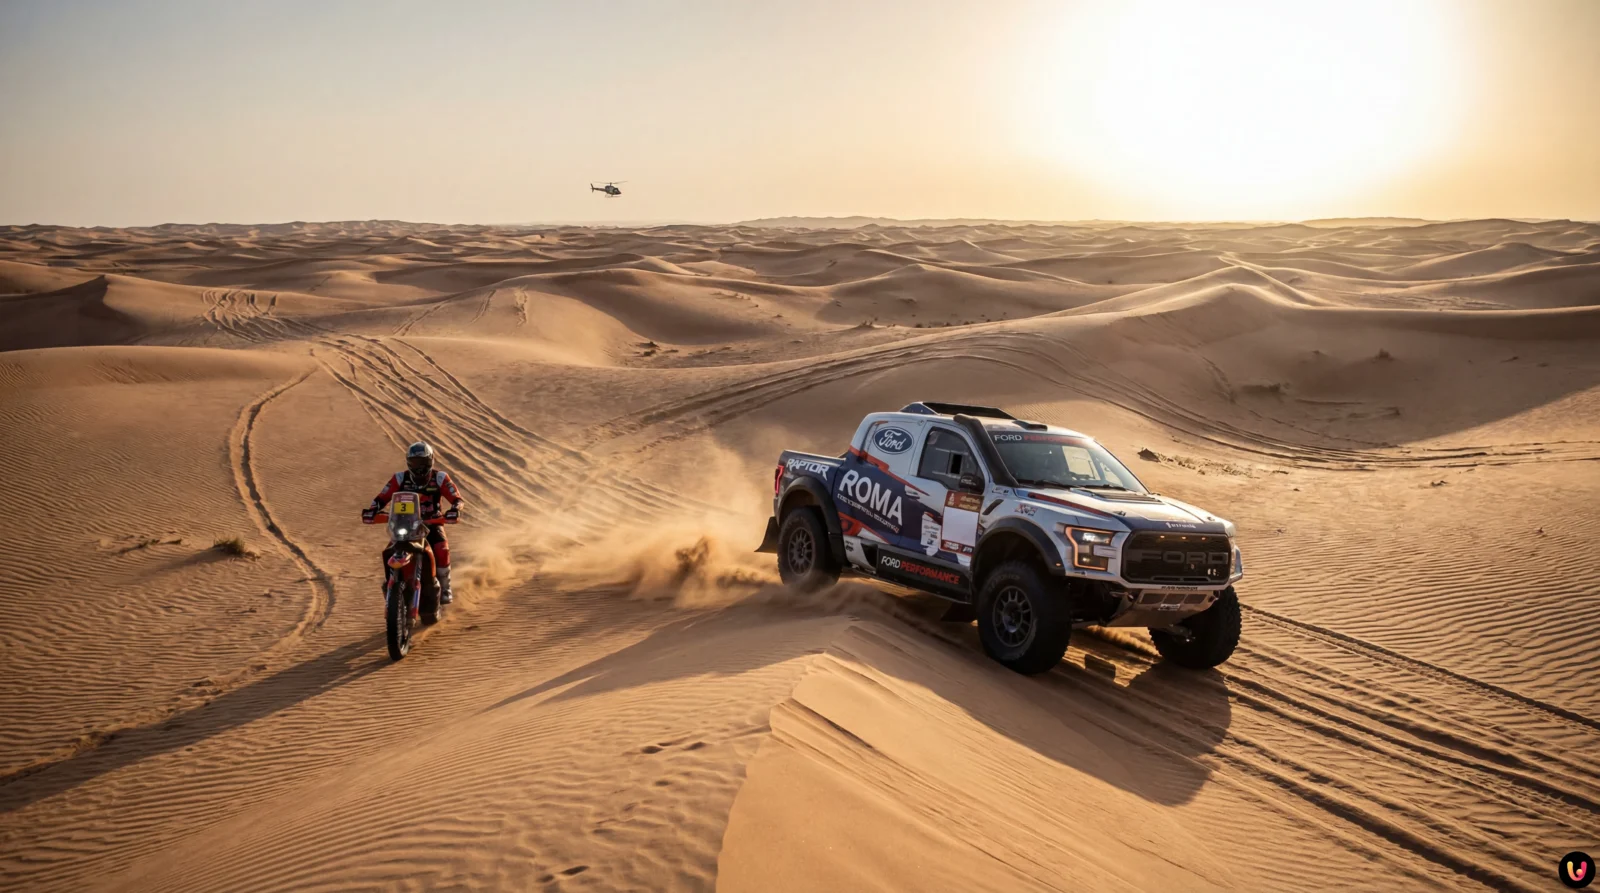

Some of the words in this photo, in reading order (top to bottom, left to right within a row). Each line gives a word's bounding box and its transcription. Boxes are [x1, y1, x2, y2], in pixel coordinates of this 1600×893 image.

[880, 429, 906, 450] Ford
[786, 458, 829, 481] RAPTOR
[400, 503, 407, 512] 3
[839, 469, 903, 526] ROMA
[1131, 549, 1229, 565] FORD
[881, 556, 901, 569] FORD
[901, 561, 960, 584] PERFORMANCE
